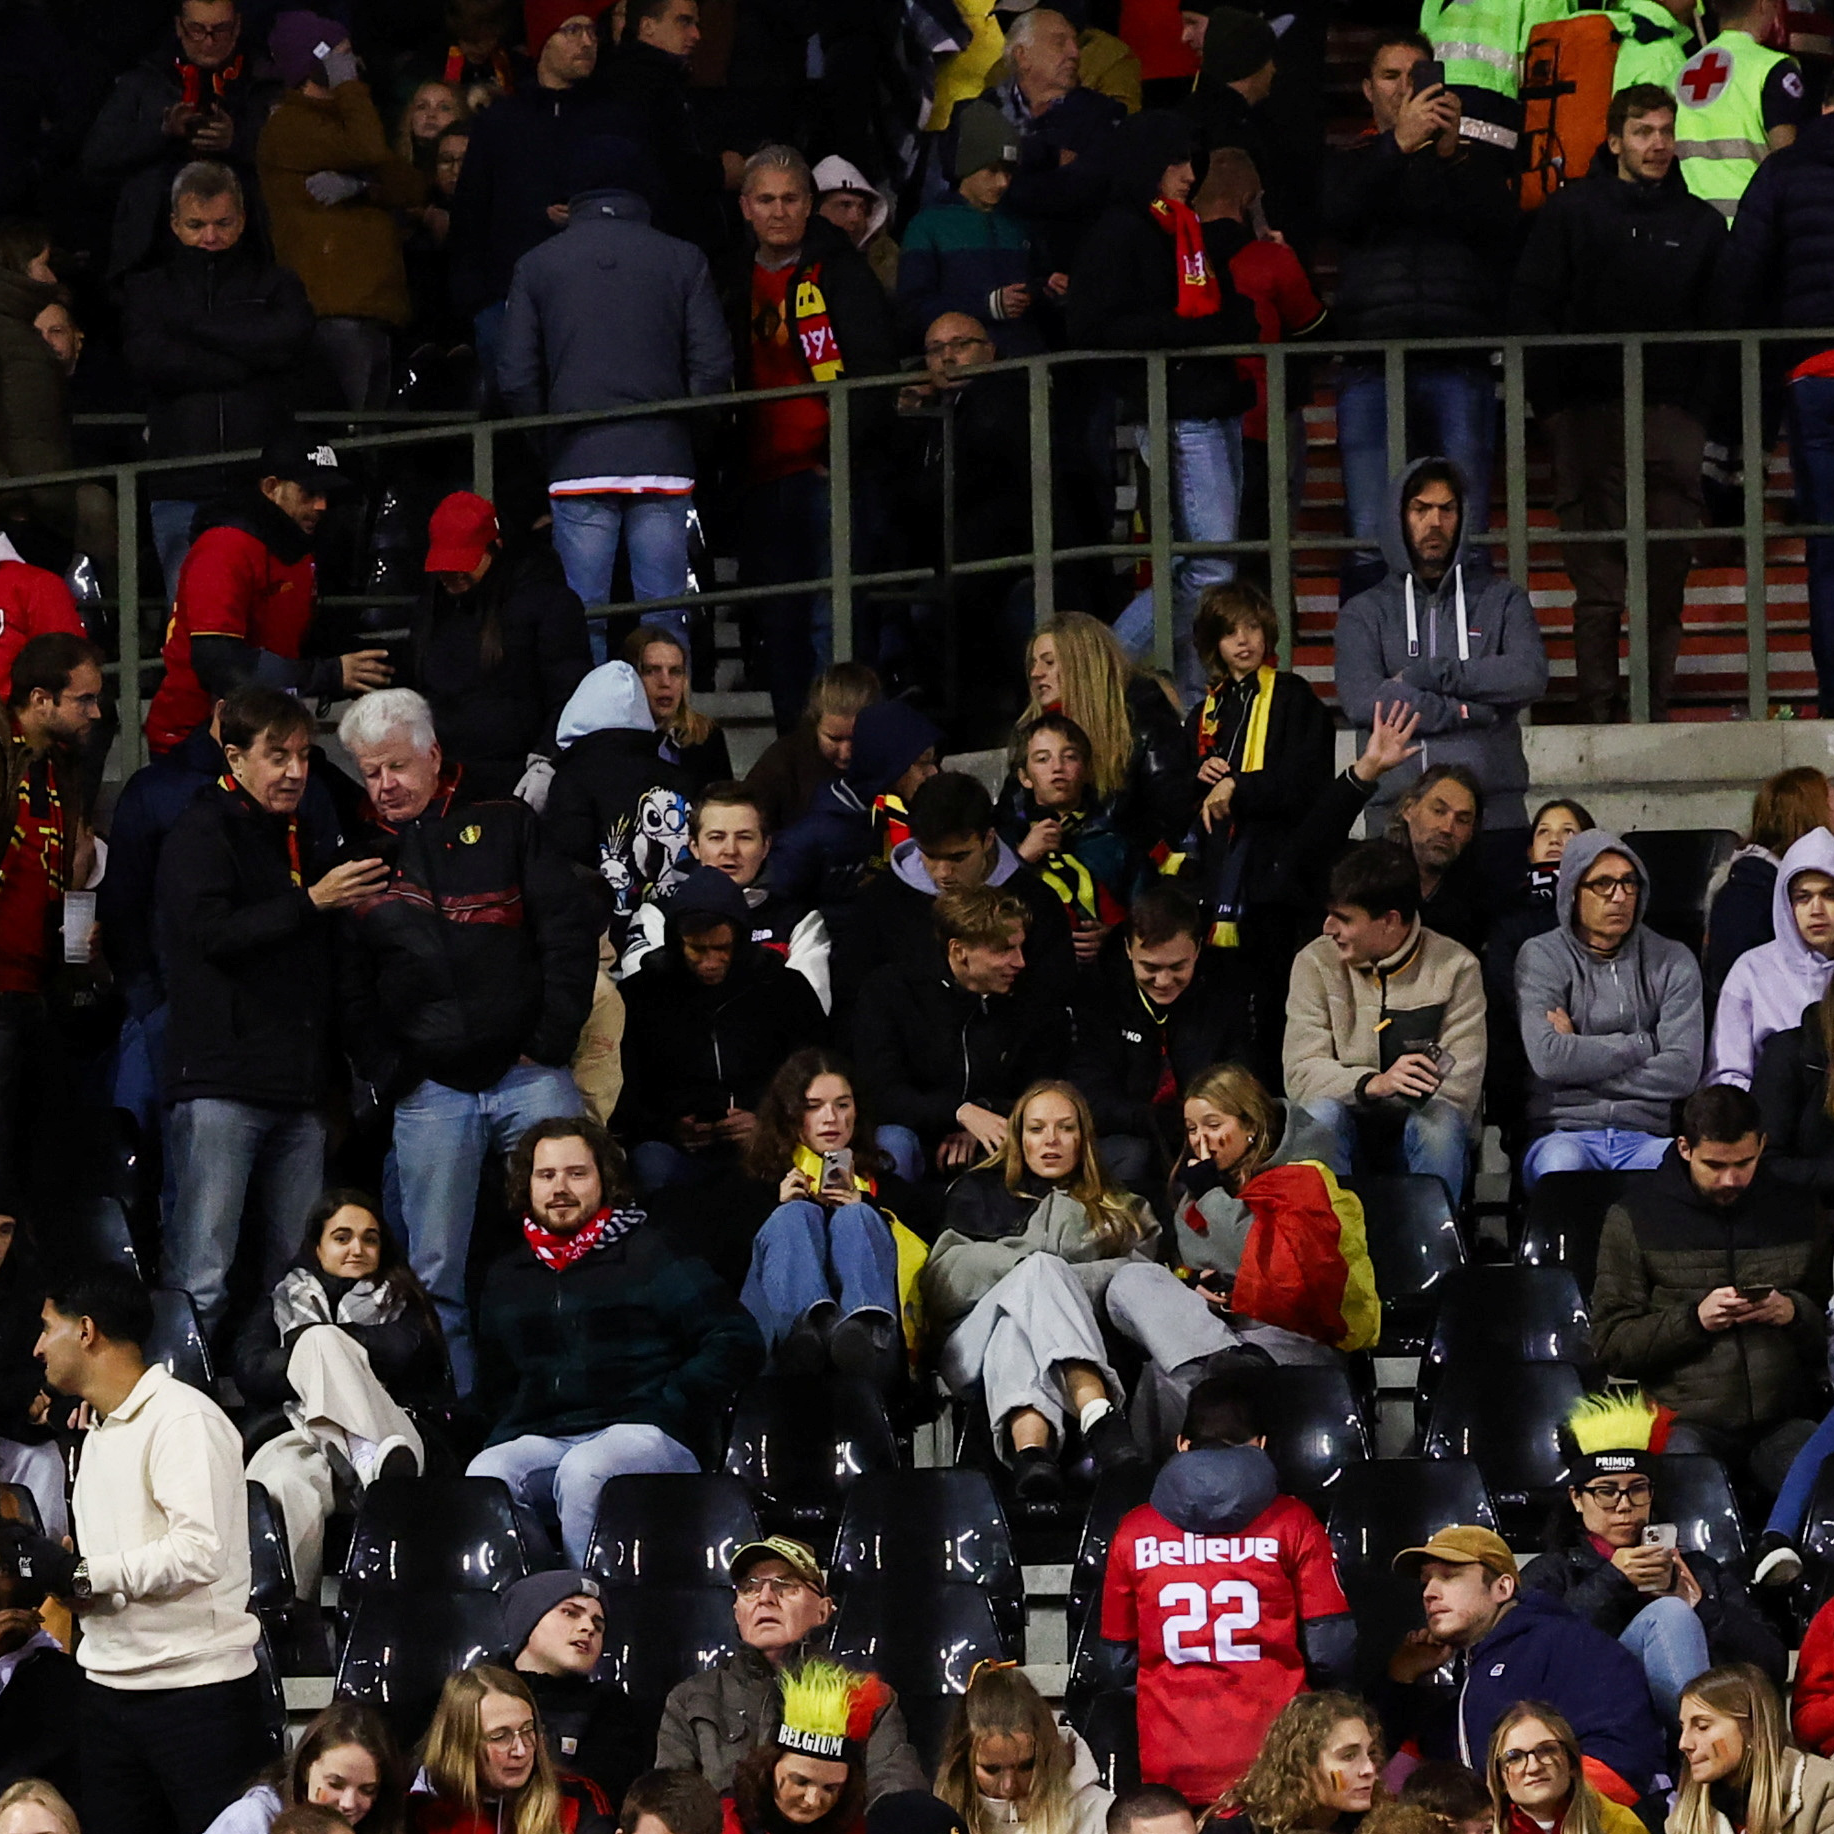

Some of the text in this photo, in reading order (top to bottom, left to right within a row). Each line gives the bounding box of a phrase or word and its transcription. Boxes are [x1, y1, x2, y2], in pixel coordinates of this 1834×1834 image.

[1594, 1456, 1636, 1467] PRIMUS
[1134, 1532, 1279, 1571] Believe
[1158, 1580, 1261, 1665] 22
[777, 1723, 846, 1758] BELGIUM
